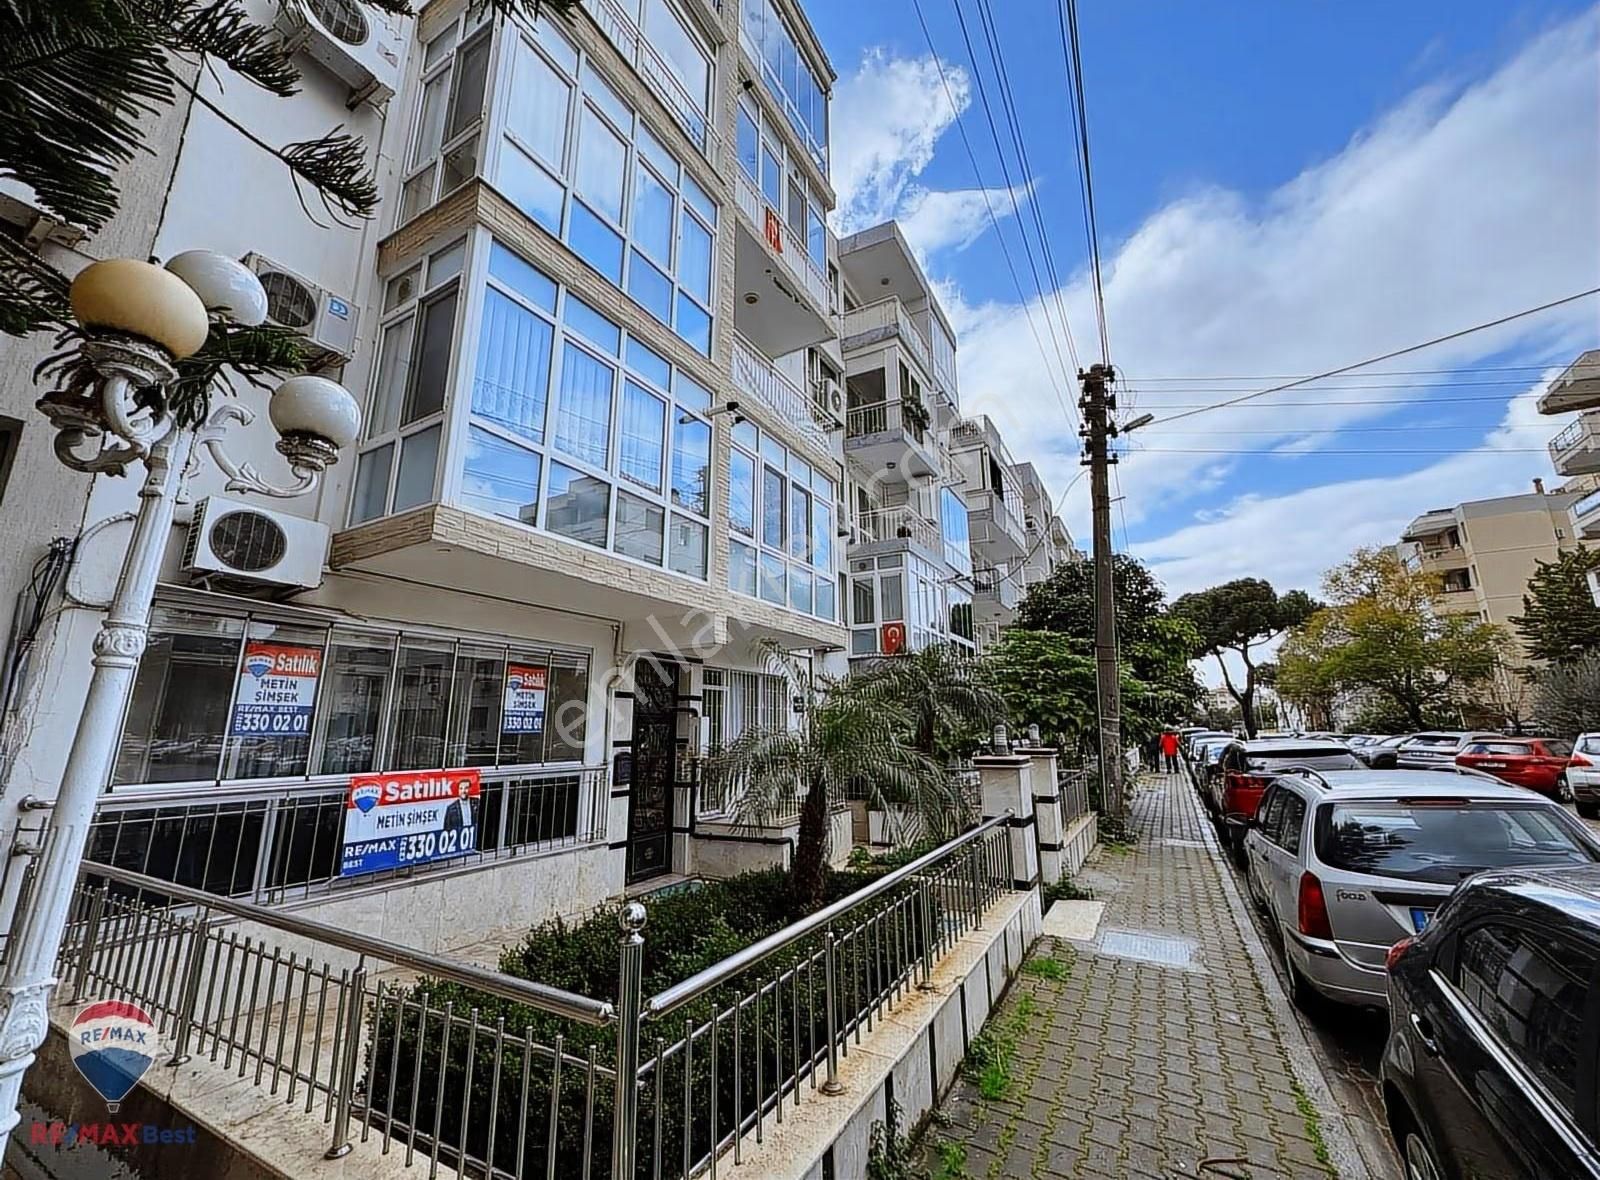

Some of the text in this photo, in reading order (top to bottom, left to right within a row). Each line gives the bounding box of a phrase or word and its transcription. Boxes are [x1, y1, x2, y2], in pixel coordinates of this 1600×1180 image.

[275, 653, 318, 673] Satılık
[259, 677, 298, 690] METİN
[255, 689, 299, 703] ŞİMŞEK
[242, 714, 270, 731] 330
[273, 715, 291, 731] 02
[294, 715, 309, 731] 01
[384, 778, 454, 802] Satılık
[376, 810, 405, 829] METİN
[344, 840, 397, 857] RE/MAX
[406, 834, 436, 860] 330
[439, 829, 458, 854] 02
[460, 826, 476, 850] 01
[343, 859, 363, 869] BEST
